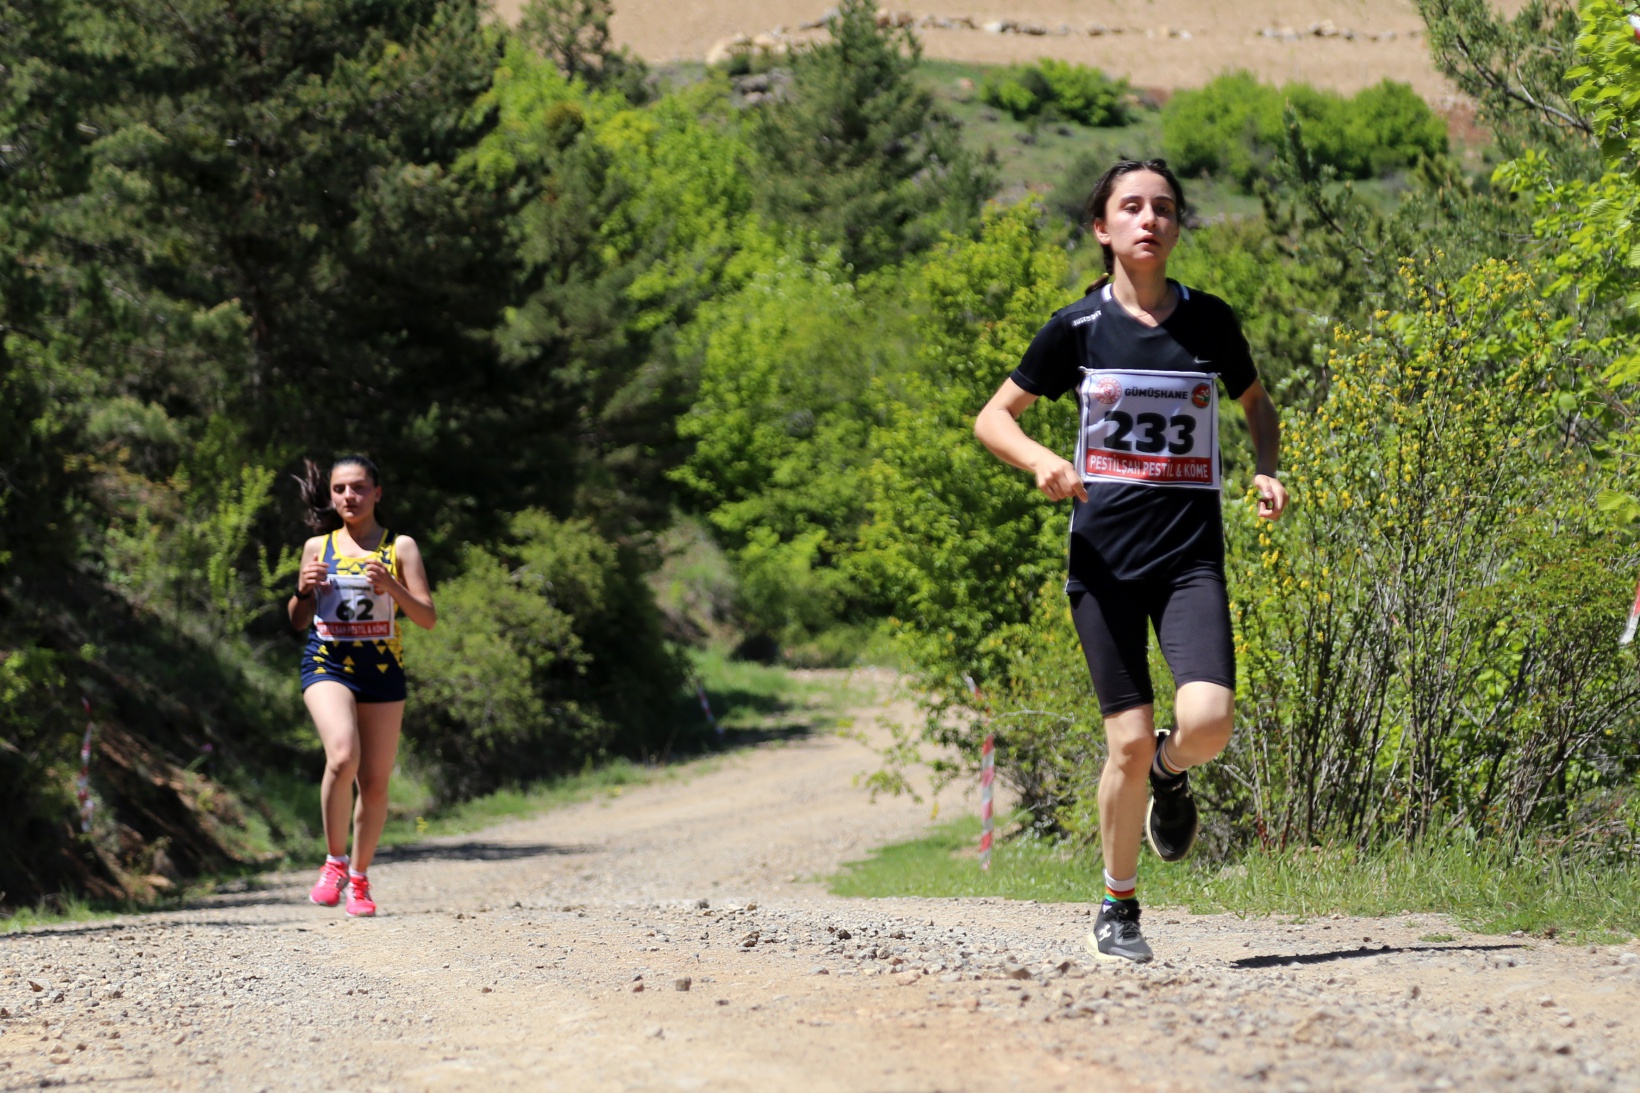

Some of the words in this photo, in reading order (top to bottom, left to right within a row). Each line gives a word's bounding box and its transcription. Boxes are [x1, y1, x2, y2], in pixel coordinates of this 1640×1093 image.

[1125, 387, 1188, 400] GÜMÜŞHANE
[1103, 411, 1197, 455] 233
[1090, 454, 1141, 475] PESTİLŞAH
[1143, 460, 1174, 478] PESTİL
[1176, 466, 1182, 477] &
[1184, 460, 1208, 478] KÖME
[336, 598, 374, 622] 62
